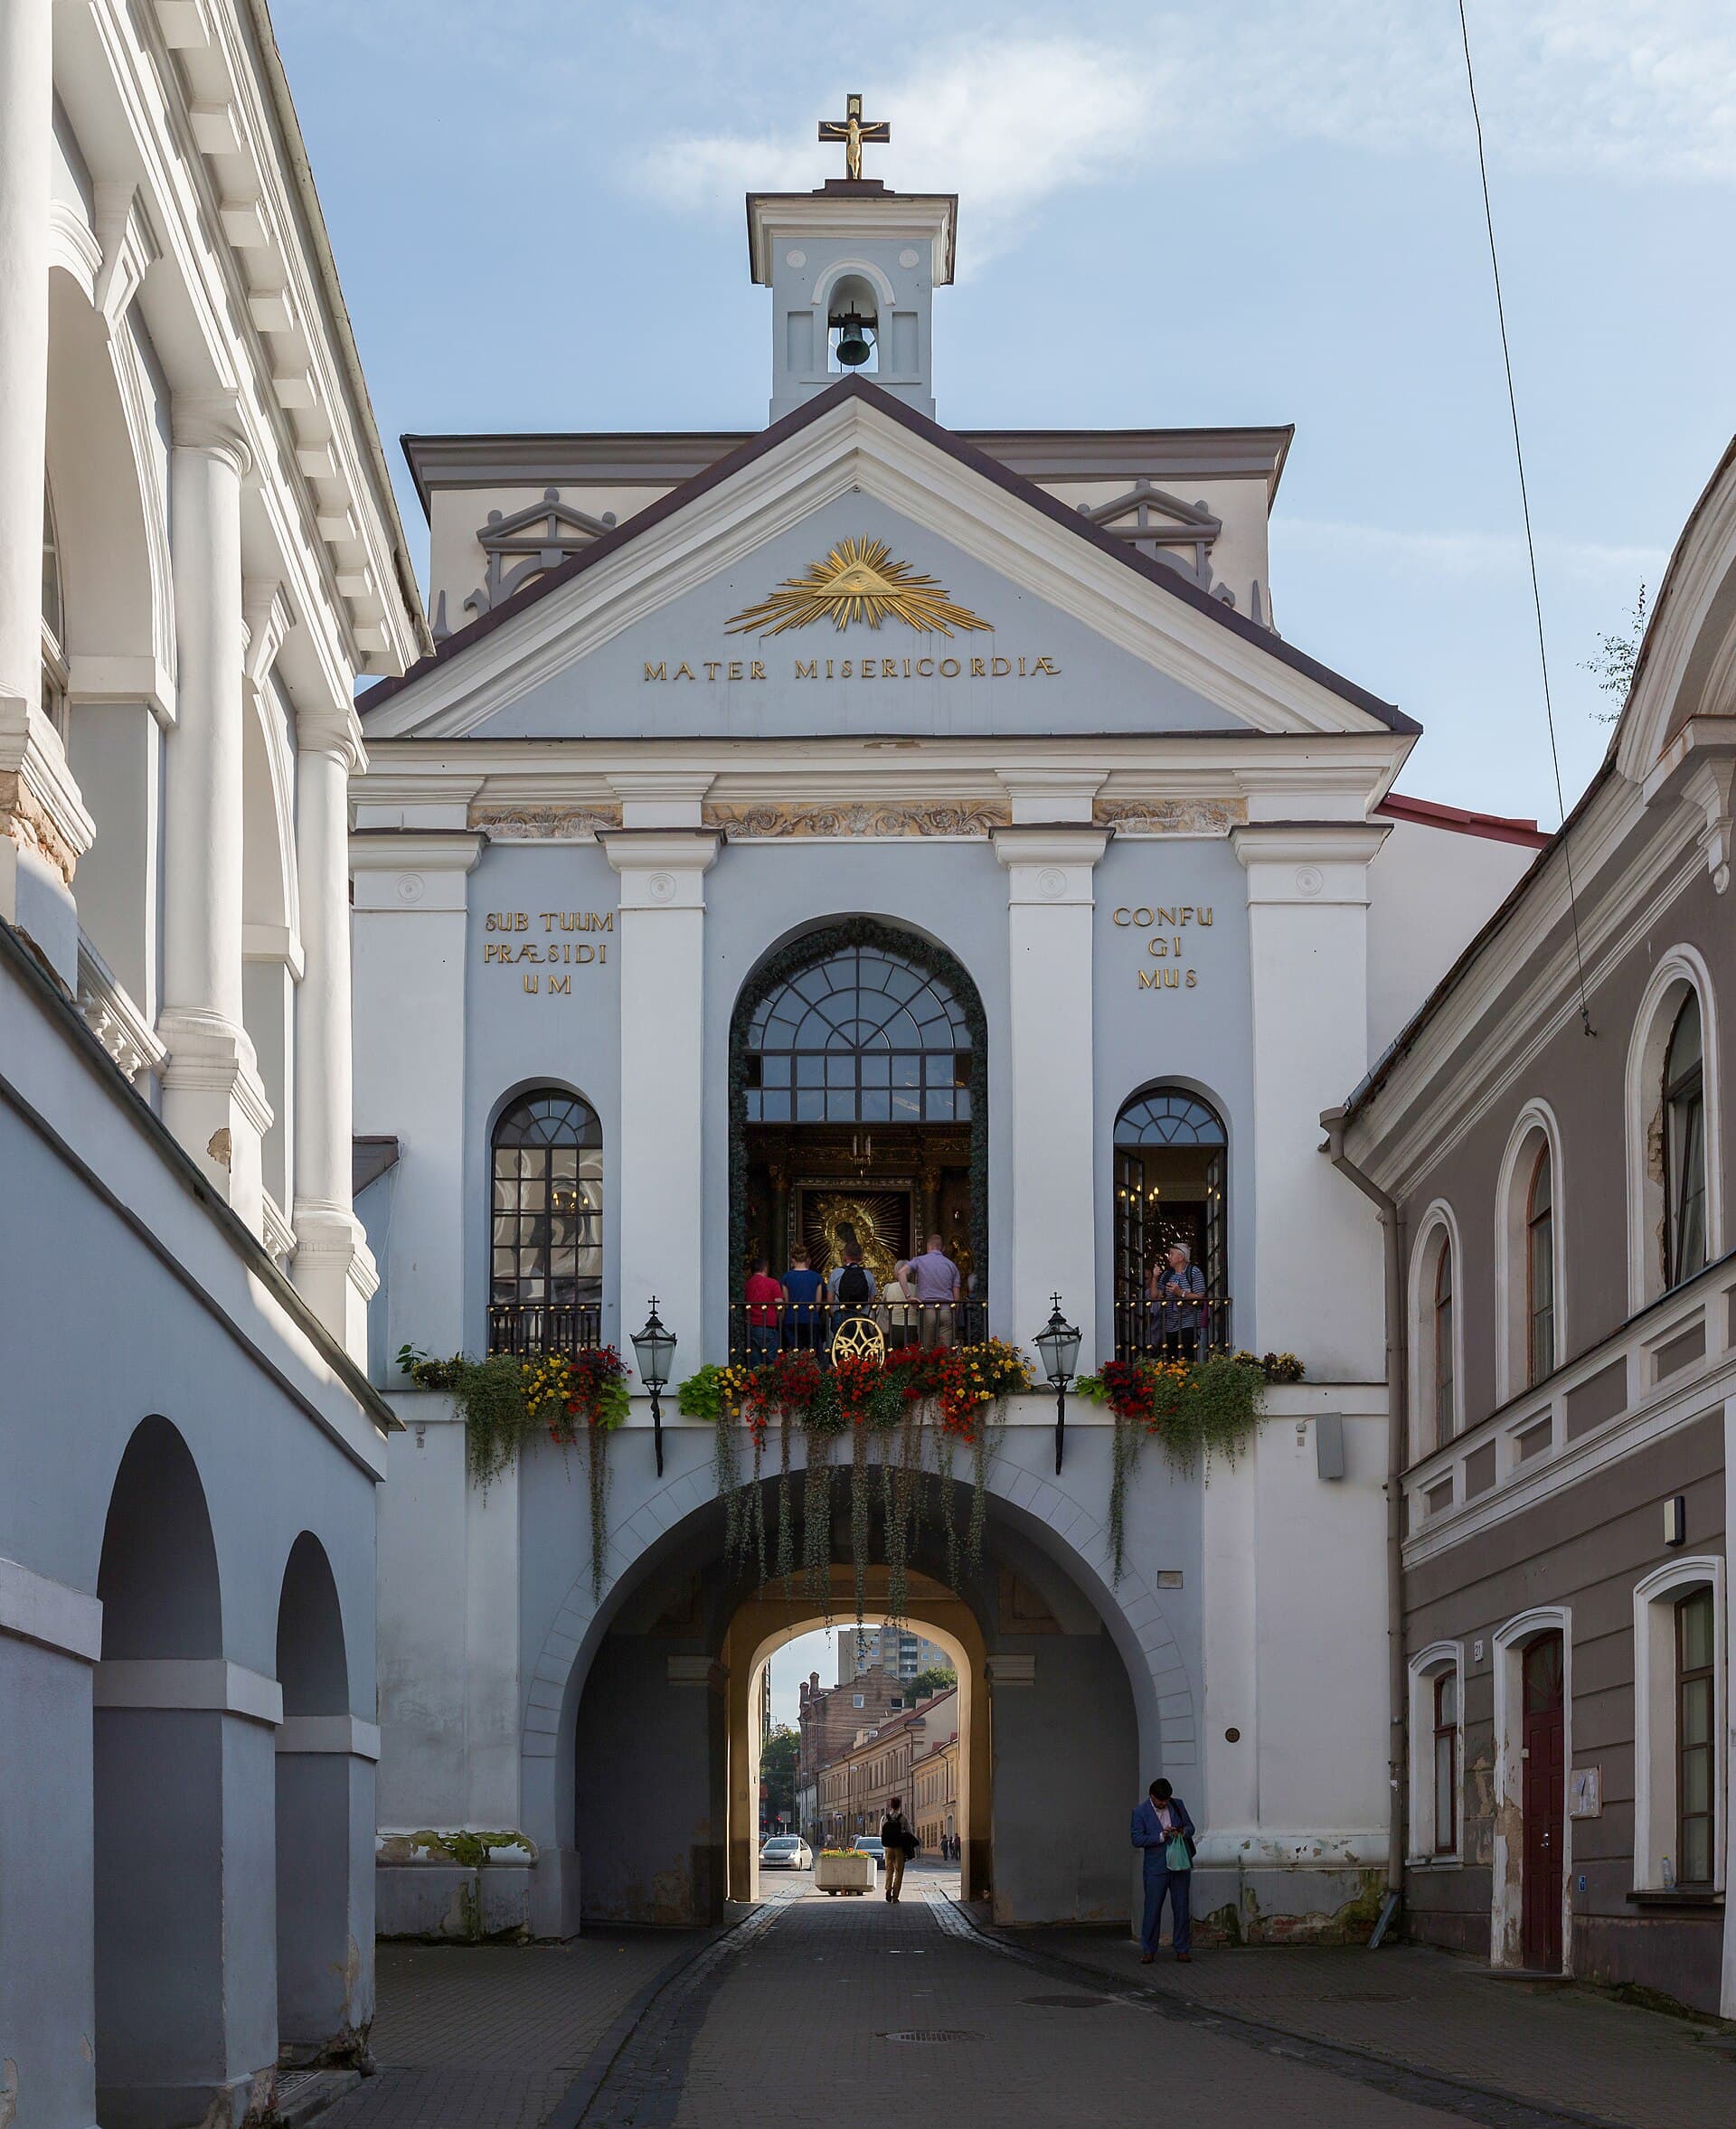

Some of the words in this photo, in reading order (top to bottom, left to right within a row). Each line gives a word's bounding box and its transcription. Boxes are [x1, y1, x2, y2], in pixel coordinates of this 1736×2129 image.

[644, 661, 767, 681] MATER
[795, 657, 1061, 679] MISERICORDIÆ
[486, 912, 529, 932] SUB
[539, 912, 614, 932] TUUM
[1113, 907, 1213, 927] CONFU
[1148, 937, 1182, 956] GI
[523, 975, 571, 994] UM
[1138, 968, 1198, 989] MUS
